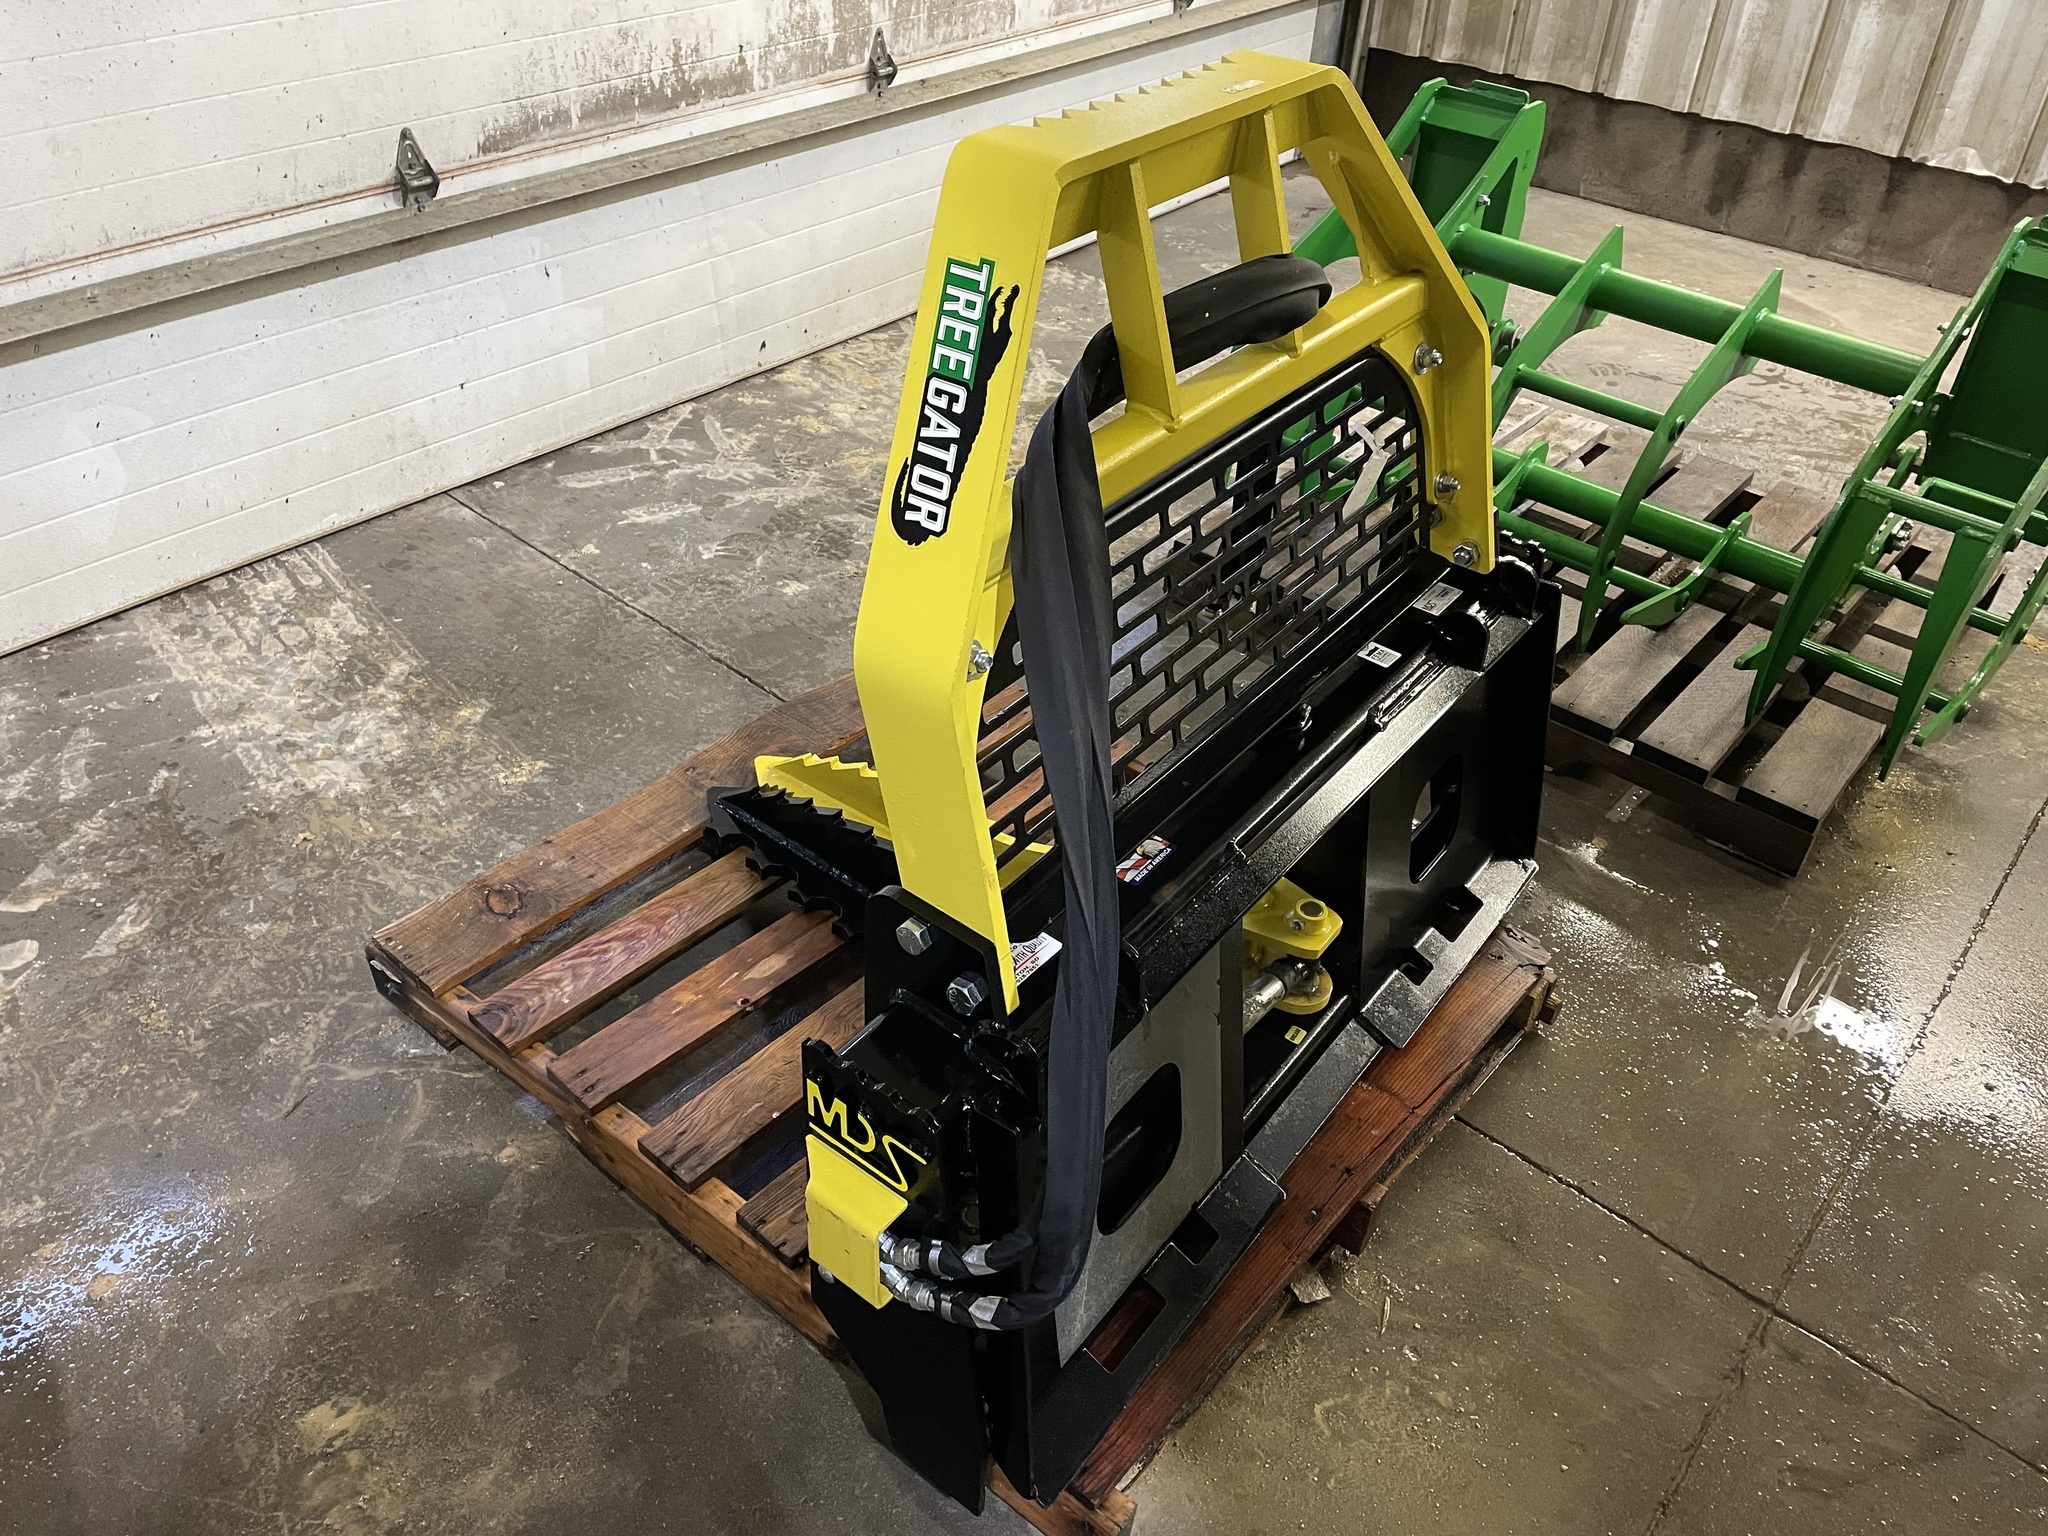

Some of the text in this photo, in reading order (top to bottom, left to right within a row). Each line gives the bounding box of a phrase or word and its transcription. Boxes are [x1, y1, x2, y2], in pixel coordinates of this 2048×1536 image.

[904, 262, 991, 534] TREE GATOR
[1134, 847, 1172, 882] MADE IN AMERICA
